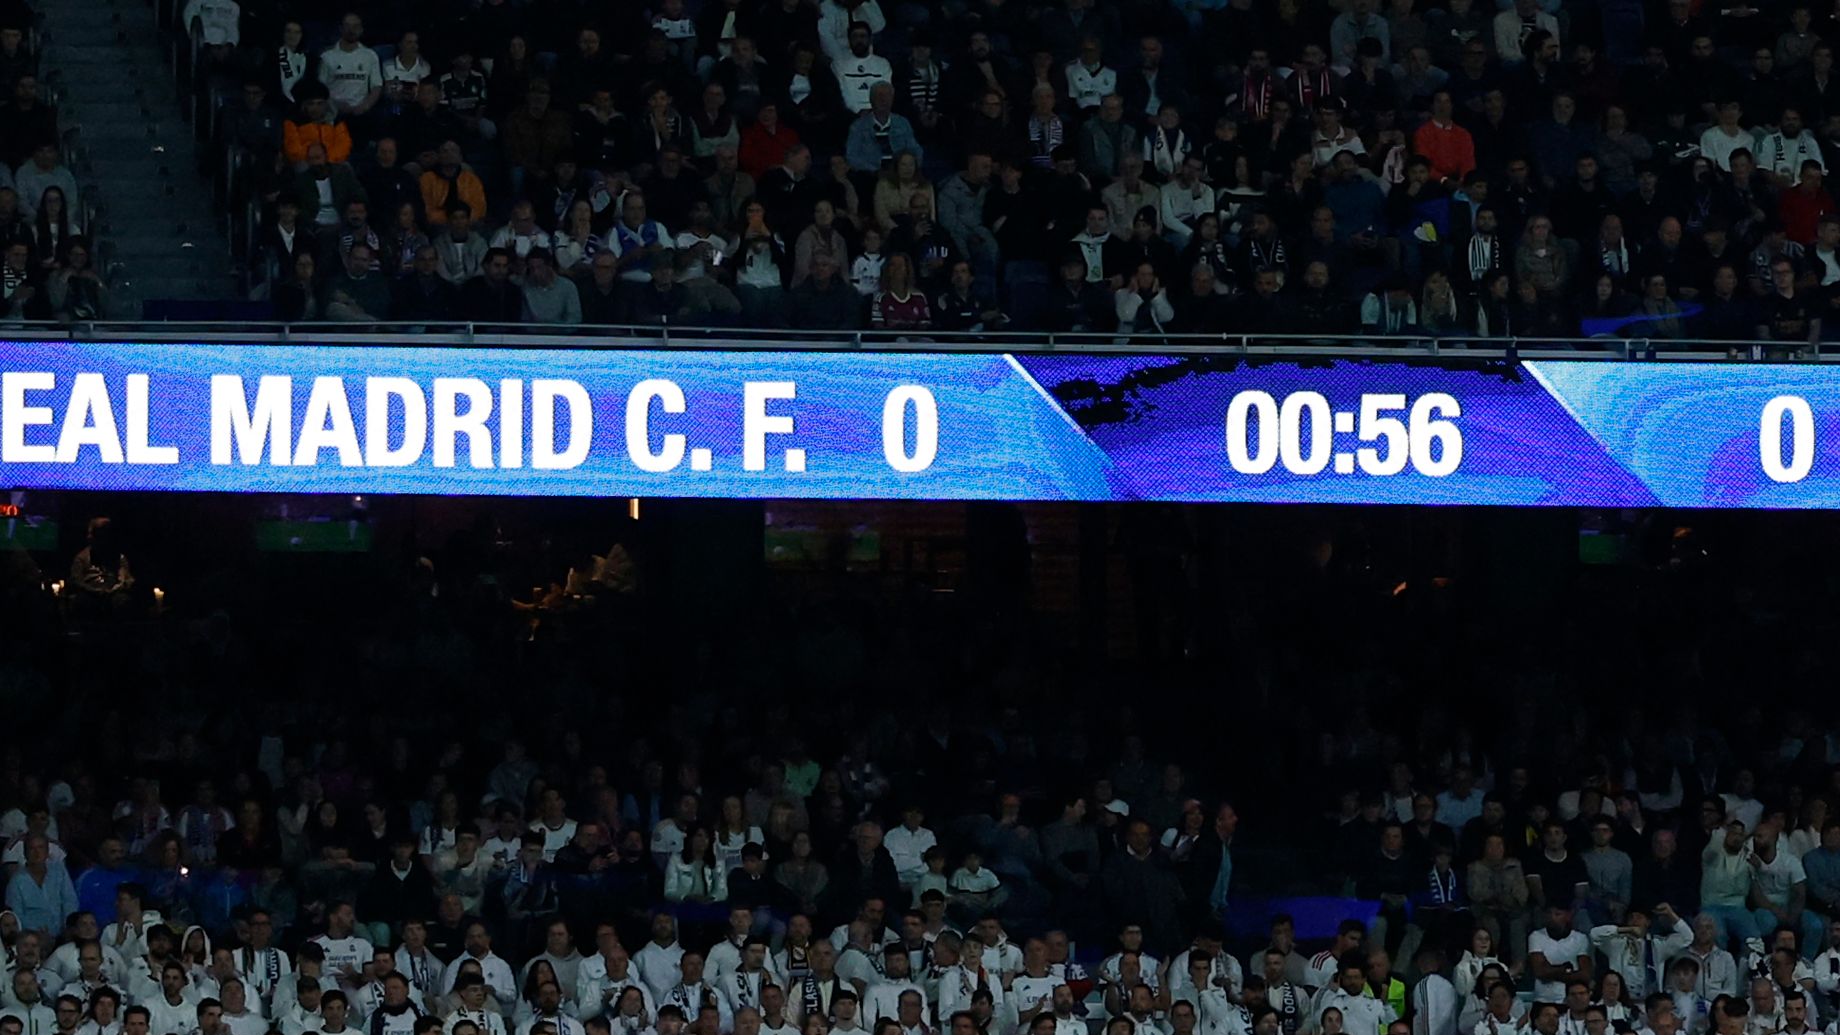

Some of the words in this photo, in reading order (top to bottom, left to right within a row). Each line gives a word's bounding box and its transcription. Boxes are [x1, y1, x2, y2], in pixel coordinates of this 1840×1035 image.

[2, 372, 179, 466] EAL
[211, 374, 593, 471] MADRID
[626, 379, 712, 473] C.
[743, 381, 806, 472] F.
[882, 385, 939, 473] 0
[1226, 390, 1463, 477] 00:56
[1759, 395, 1816, 483] 0
